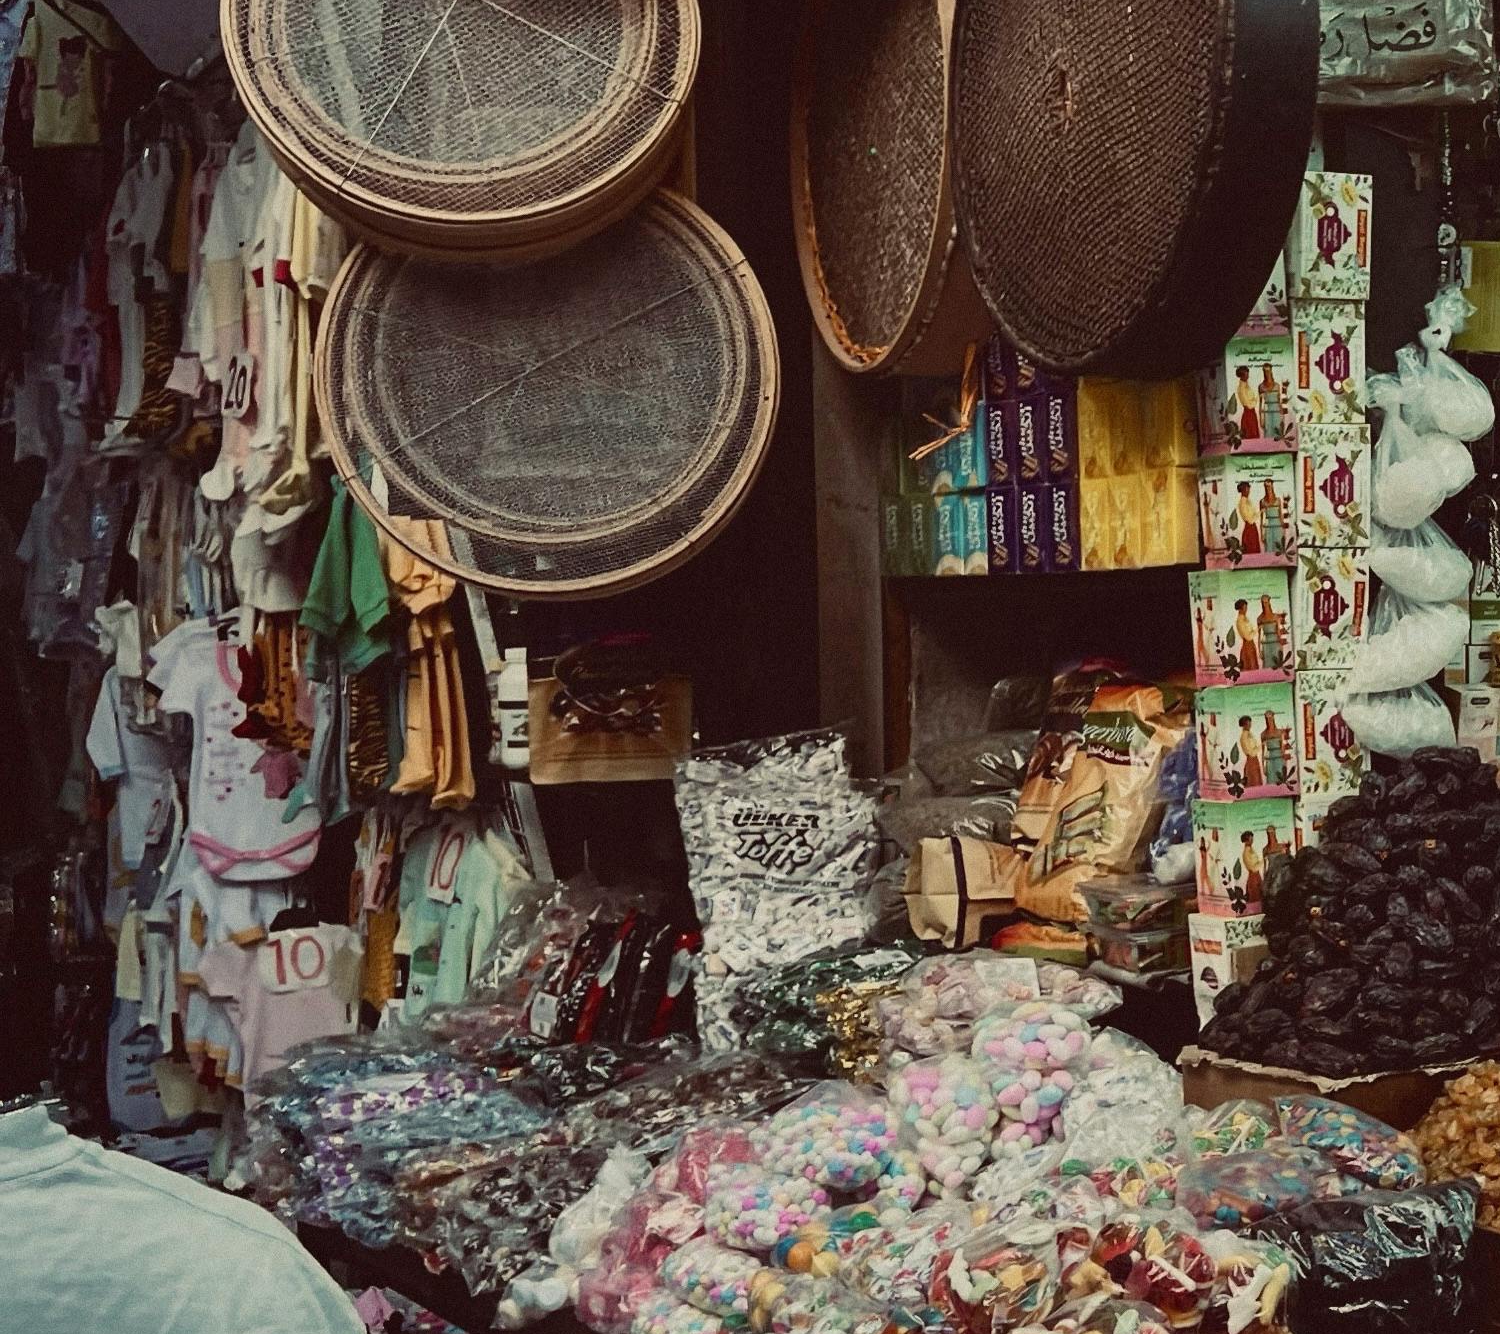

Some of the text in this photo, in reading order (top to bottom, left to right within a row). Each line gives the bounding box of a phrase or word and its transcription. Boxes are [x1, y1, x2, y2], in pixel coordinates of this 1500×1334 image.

[224, 356, 247, 410] 20
[430, 832, 465, 890] 10
[267, 935, 324, 985] 10
